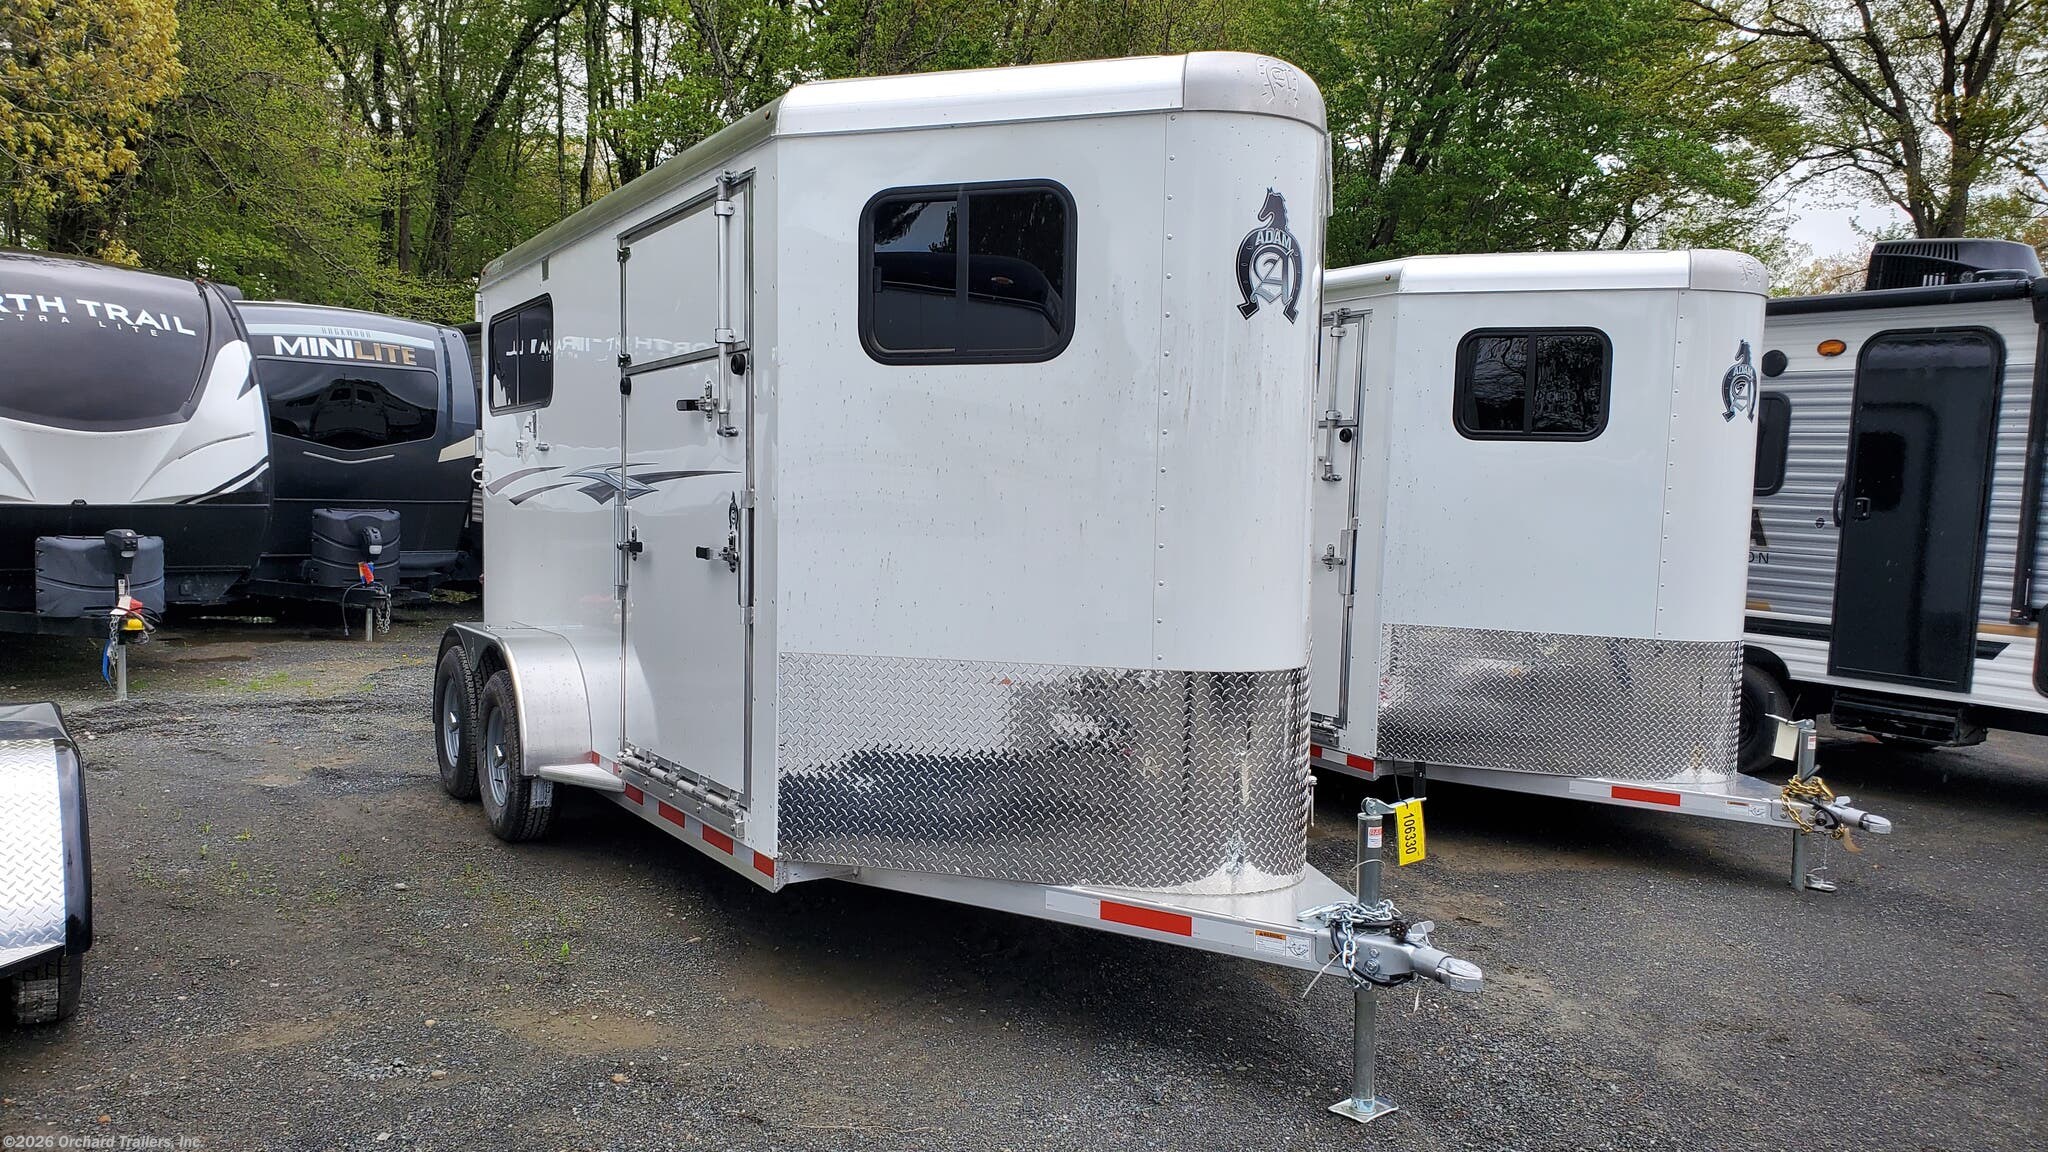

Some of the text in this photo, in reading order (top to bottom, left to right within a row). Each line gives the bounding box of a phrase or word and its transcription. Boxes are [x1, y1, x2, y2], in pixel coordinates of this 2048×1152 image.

[1255, 229, 1292, 251] ADAM
[0, 313, 159, 337] TRA LITE
[76, 298, 197, 337] TRAIL
[1403, 812, 1417, 855] 106330
